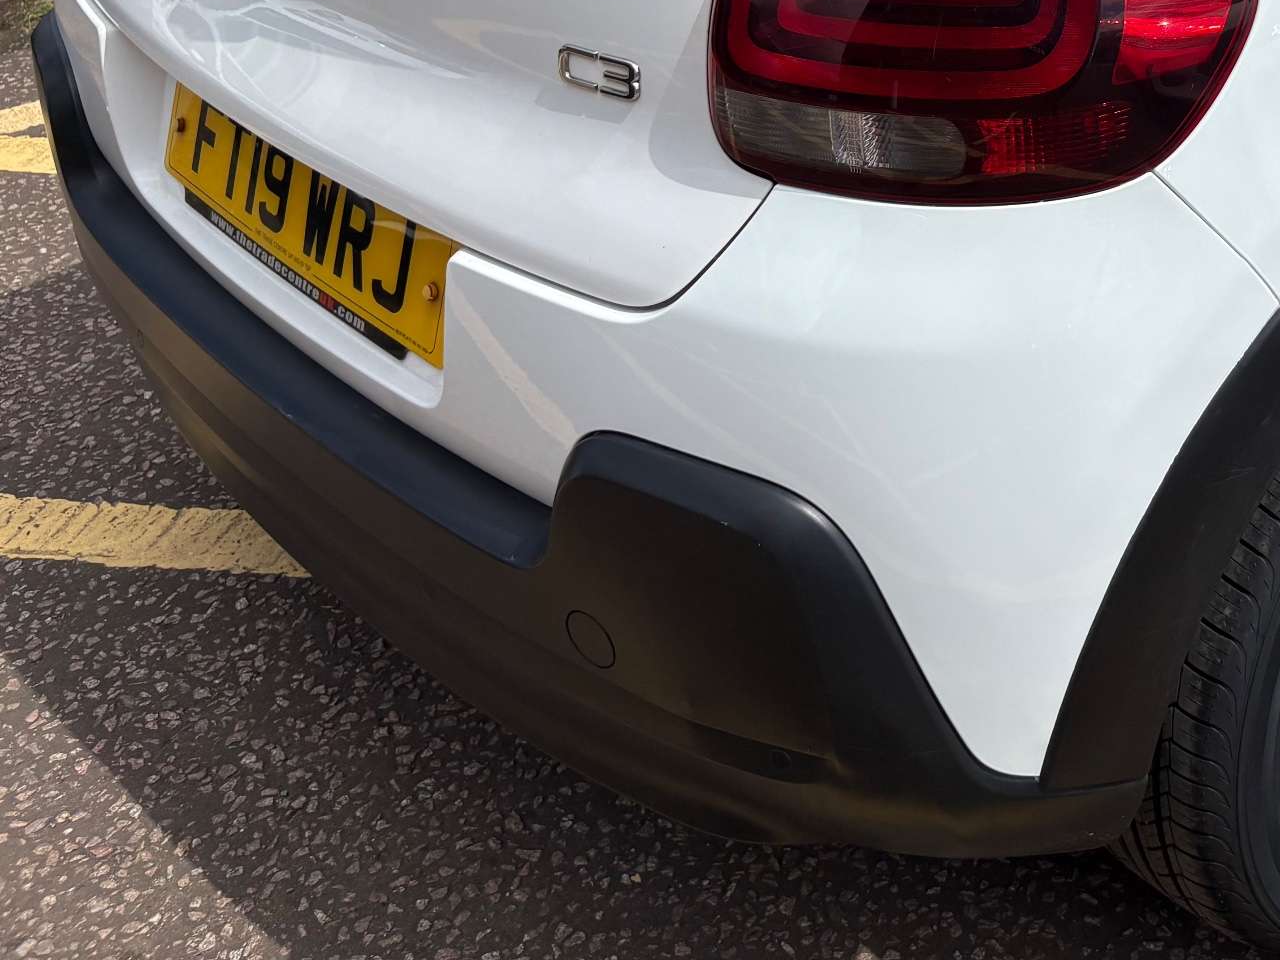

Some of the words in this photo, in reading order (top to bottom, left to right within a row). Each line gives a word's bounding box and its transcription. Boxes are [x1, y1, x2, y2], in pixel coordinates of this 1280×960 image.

[558, 43, 642, 102] C3
[191, 99, 295, 234] FT19
[302, 167, 417, 314] WRJ
